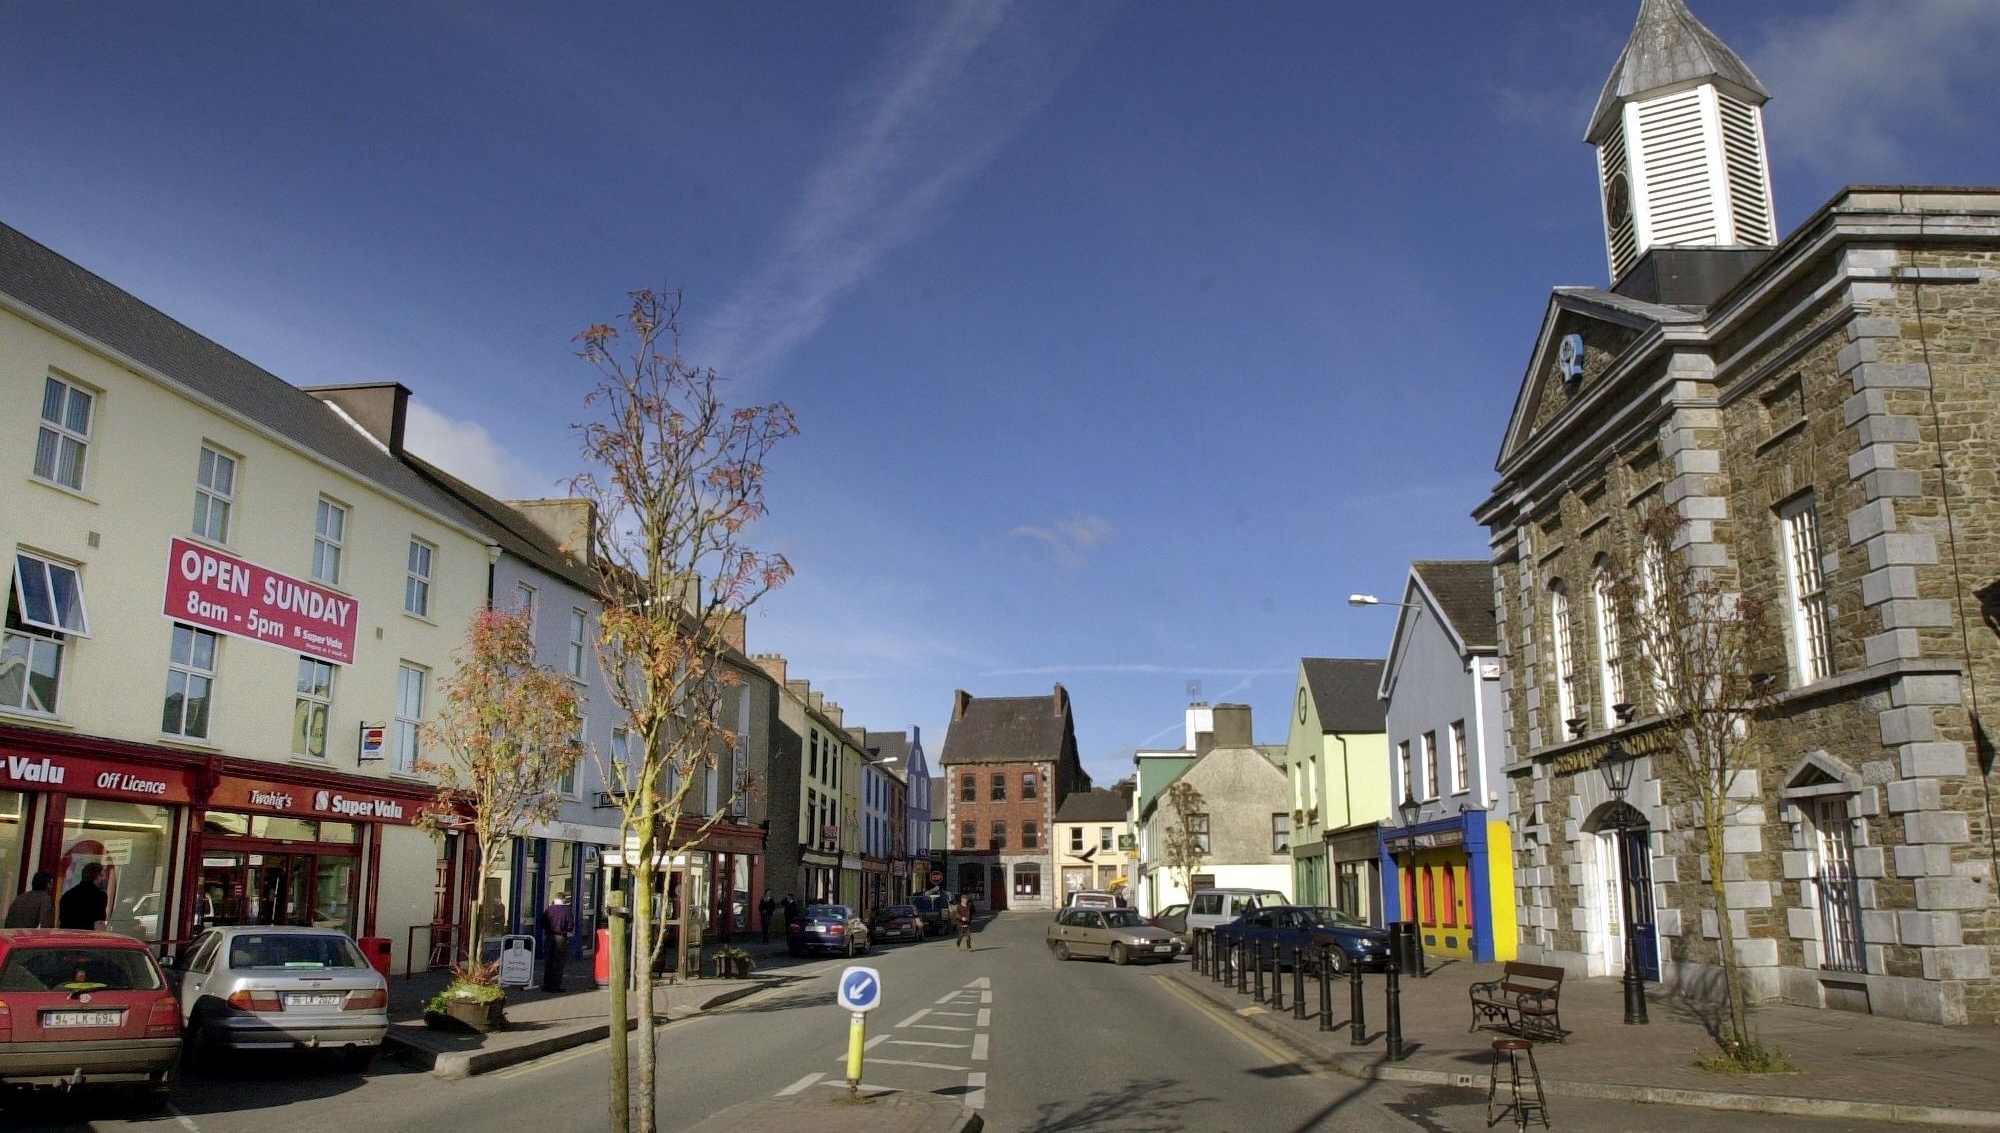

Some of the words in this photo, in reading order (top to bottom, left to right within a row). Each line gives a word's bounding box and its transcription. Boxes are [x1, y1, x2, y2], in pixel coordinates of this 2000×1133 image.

[181, 549, 250, 597] OPEN
[263, 576, 350, 628] SUNDAY
[186, 591, 228, 622] 8am
[247, 608, 284, 638] 5pm
[8, 755, 65, 784] Valu
[97, 772, 121, 789] Off
[121, 774, 166, 795] Licence
[251, 790, 293, 810] Twohig's
